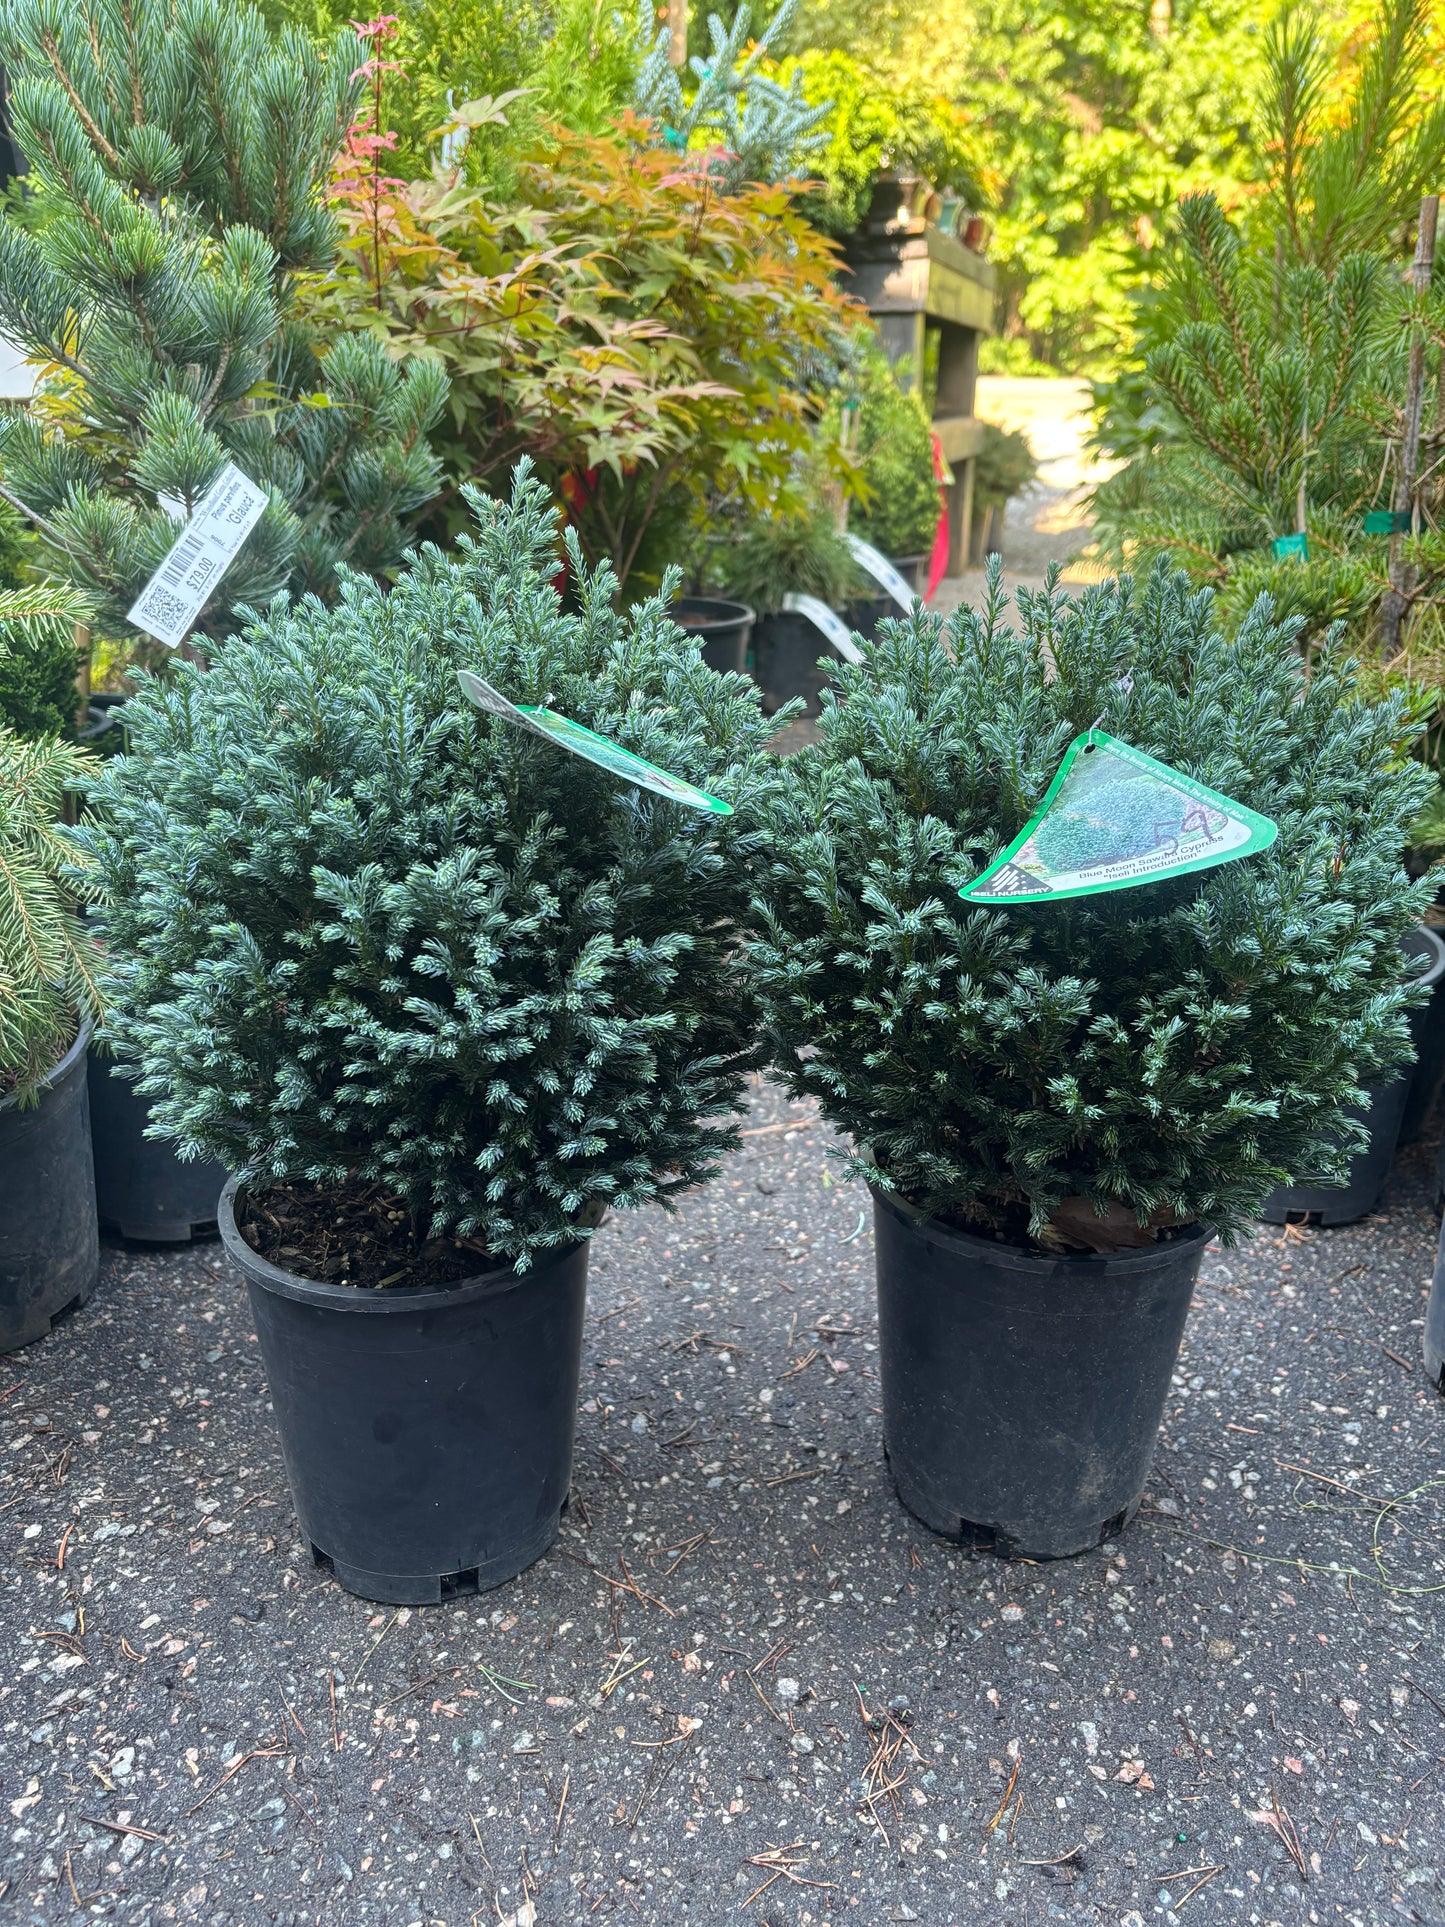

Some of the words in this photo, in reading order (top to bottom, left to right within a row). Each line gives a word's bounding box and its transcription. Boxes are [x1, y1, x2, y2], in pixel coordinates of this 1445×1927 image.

[226, 491, 255, 525] 'Glauca'
[186, 557, 213, 590] $79.00
[1130, 756, 1148, 771] Beauty
[1152, 768, 1172, 782] Nature
[1173, 777, 1190, 791] Meets
[1190, 786, 1201, 797] The
[1079, 869, 1103, 879] Blue
[1105, 862, 1136, 873] Moon
[1180, 834, 1224, 854] Cypress
[998, 887, 1050, 897] NURSERY
